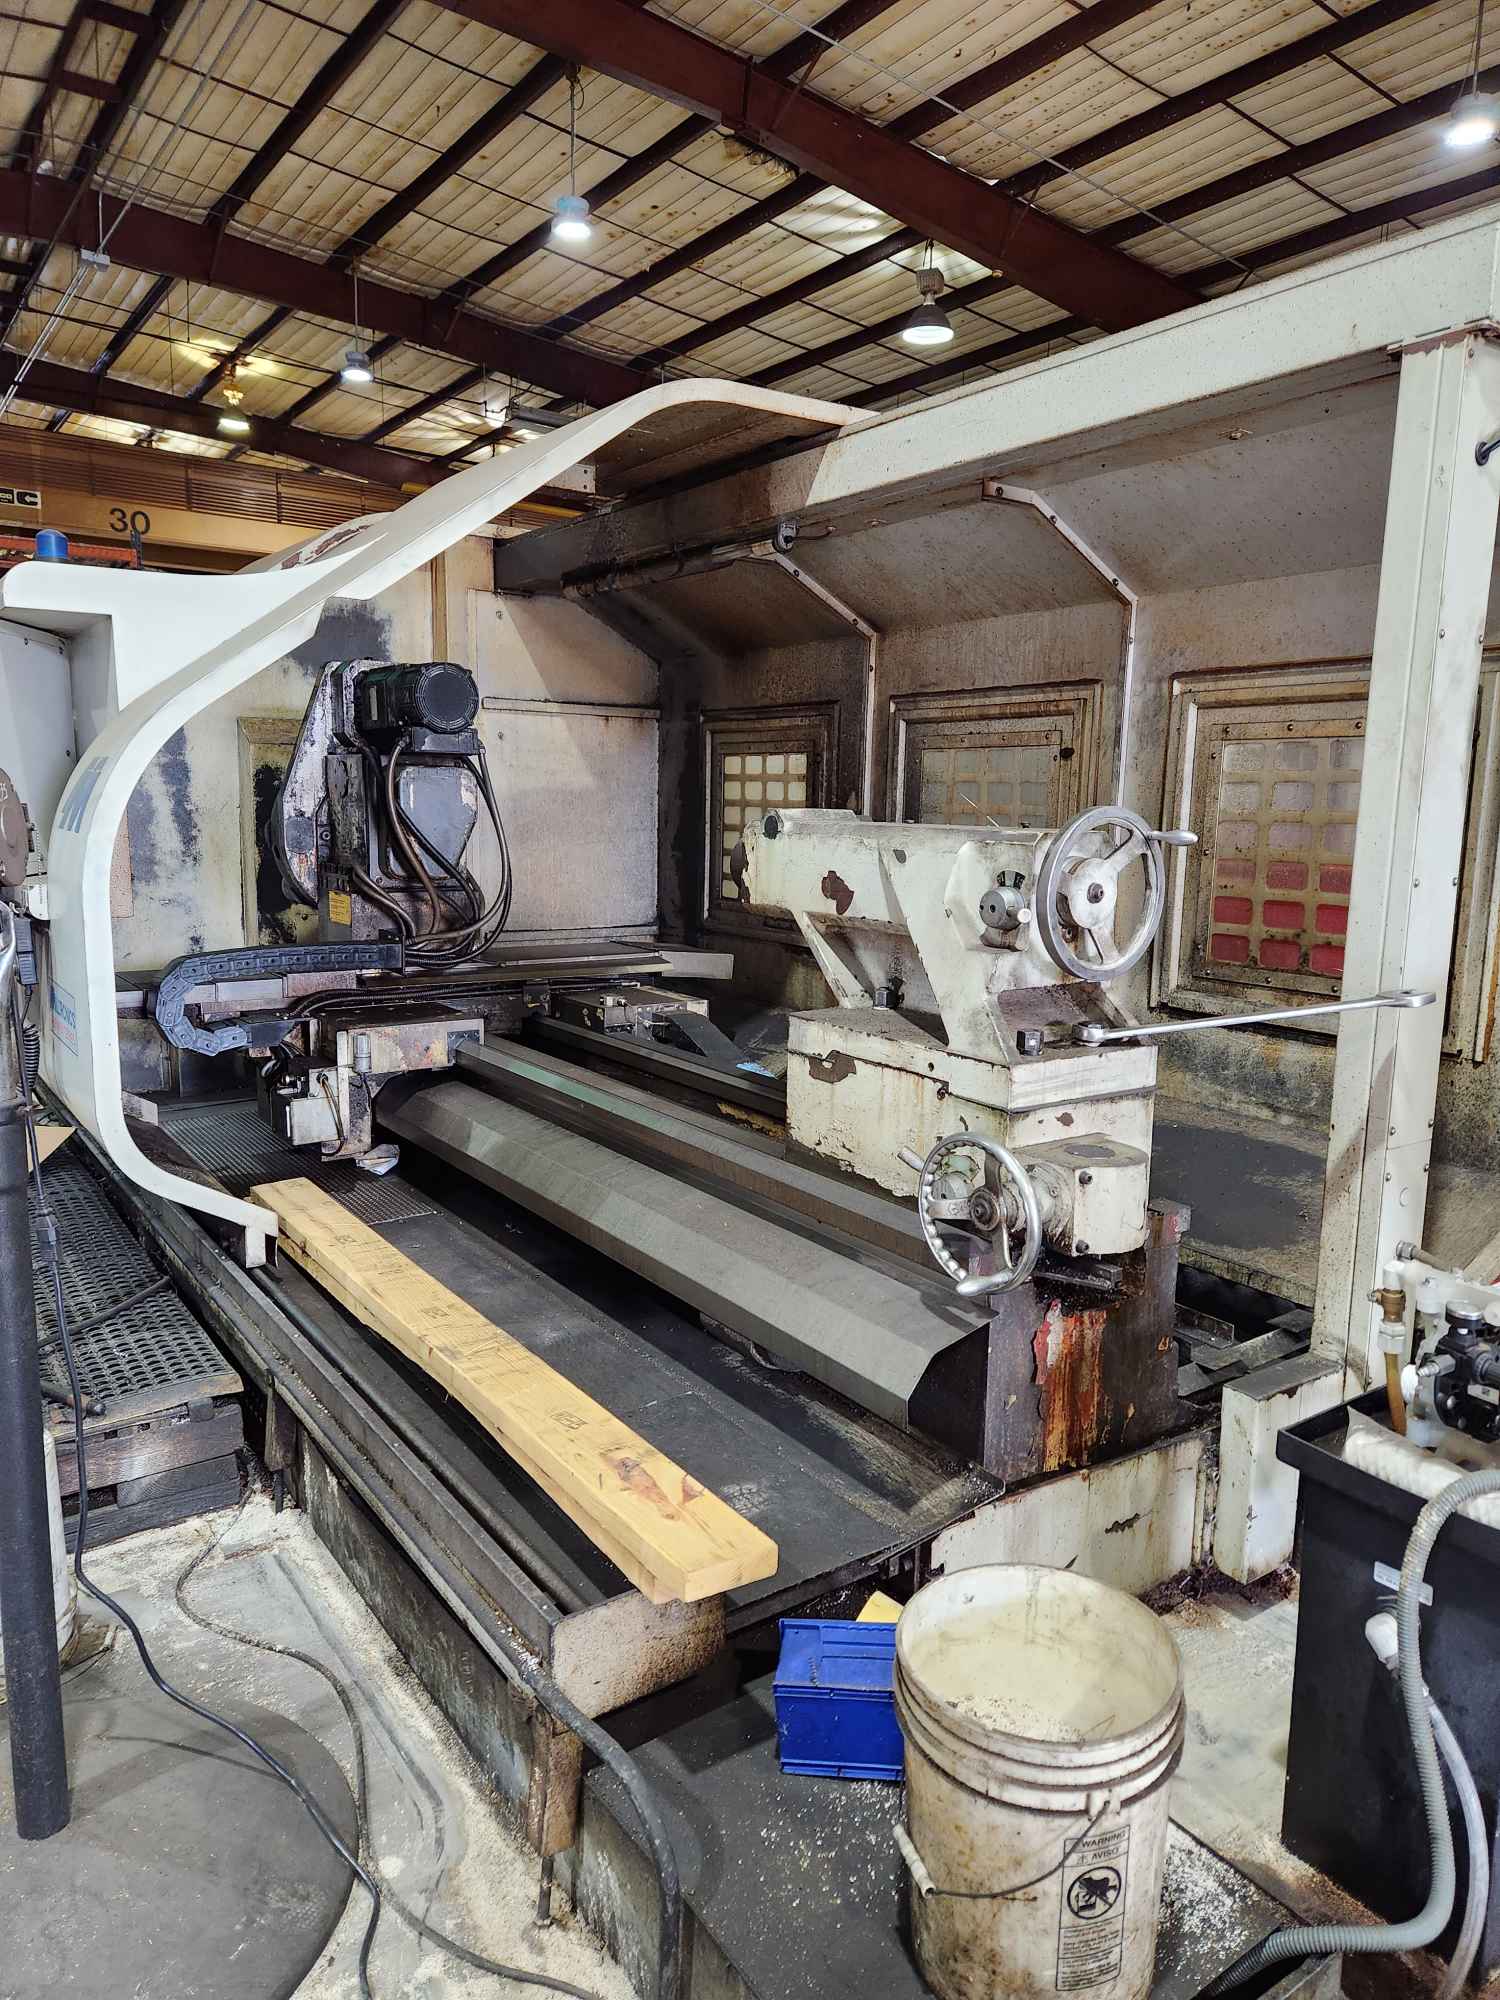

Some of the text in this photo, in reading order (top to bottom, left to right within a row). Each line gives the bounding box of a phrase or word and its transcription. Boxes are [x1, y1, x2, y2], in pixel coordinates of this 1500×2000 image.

[109, 507, 150, 535] 30
[1082, 1830, 1126, 1848] WARNING
[1091, 1846, 1119, 1860] AVISO
